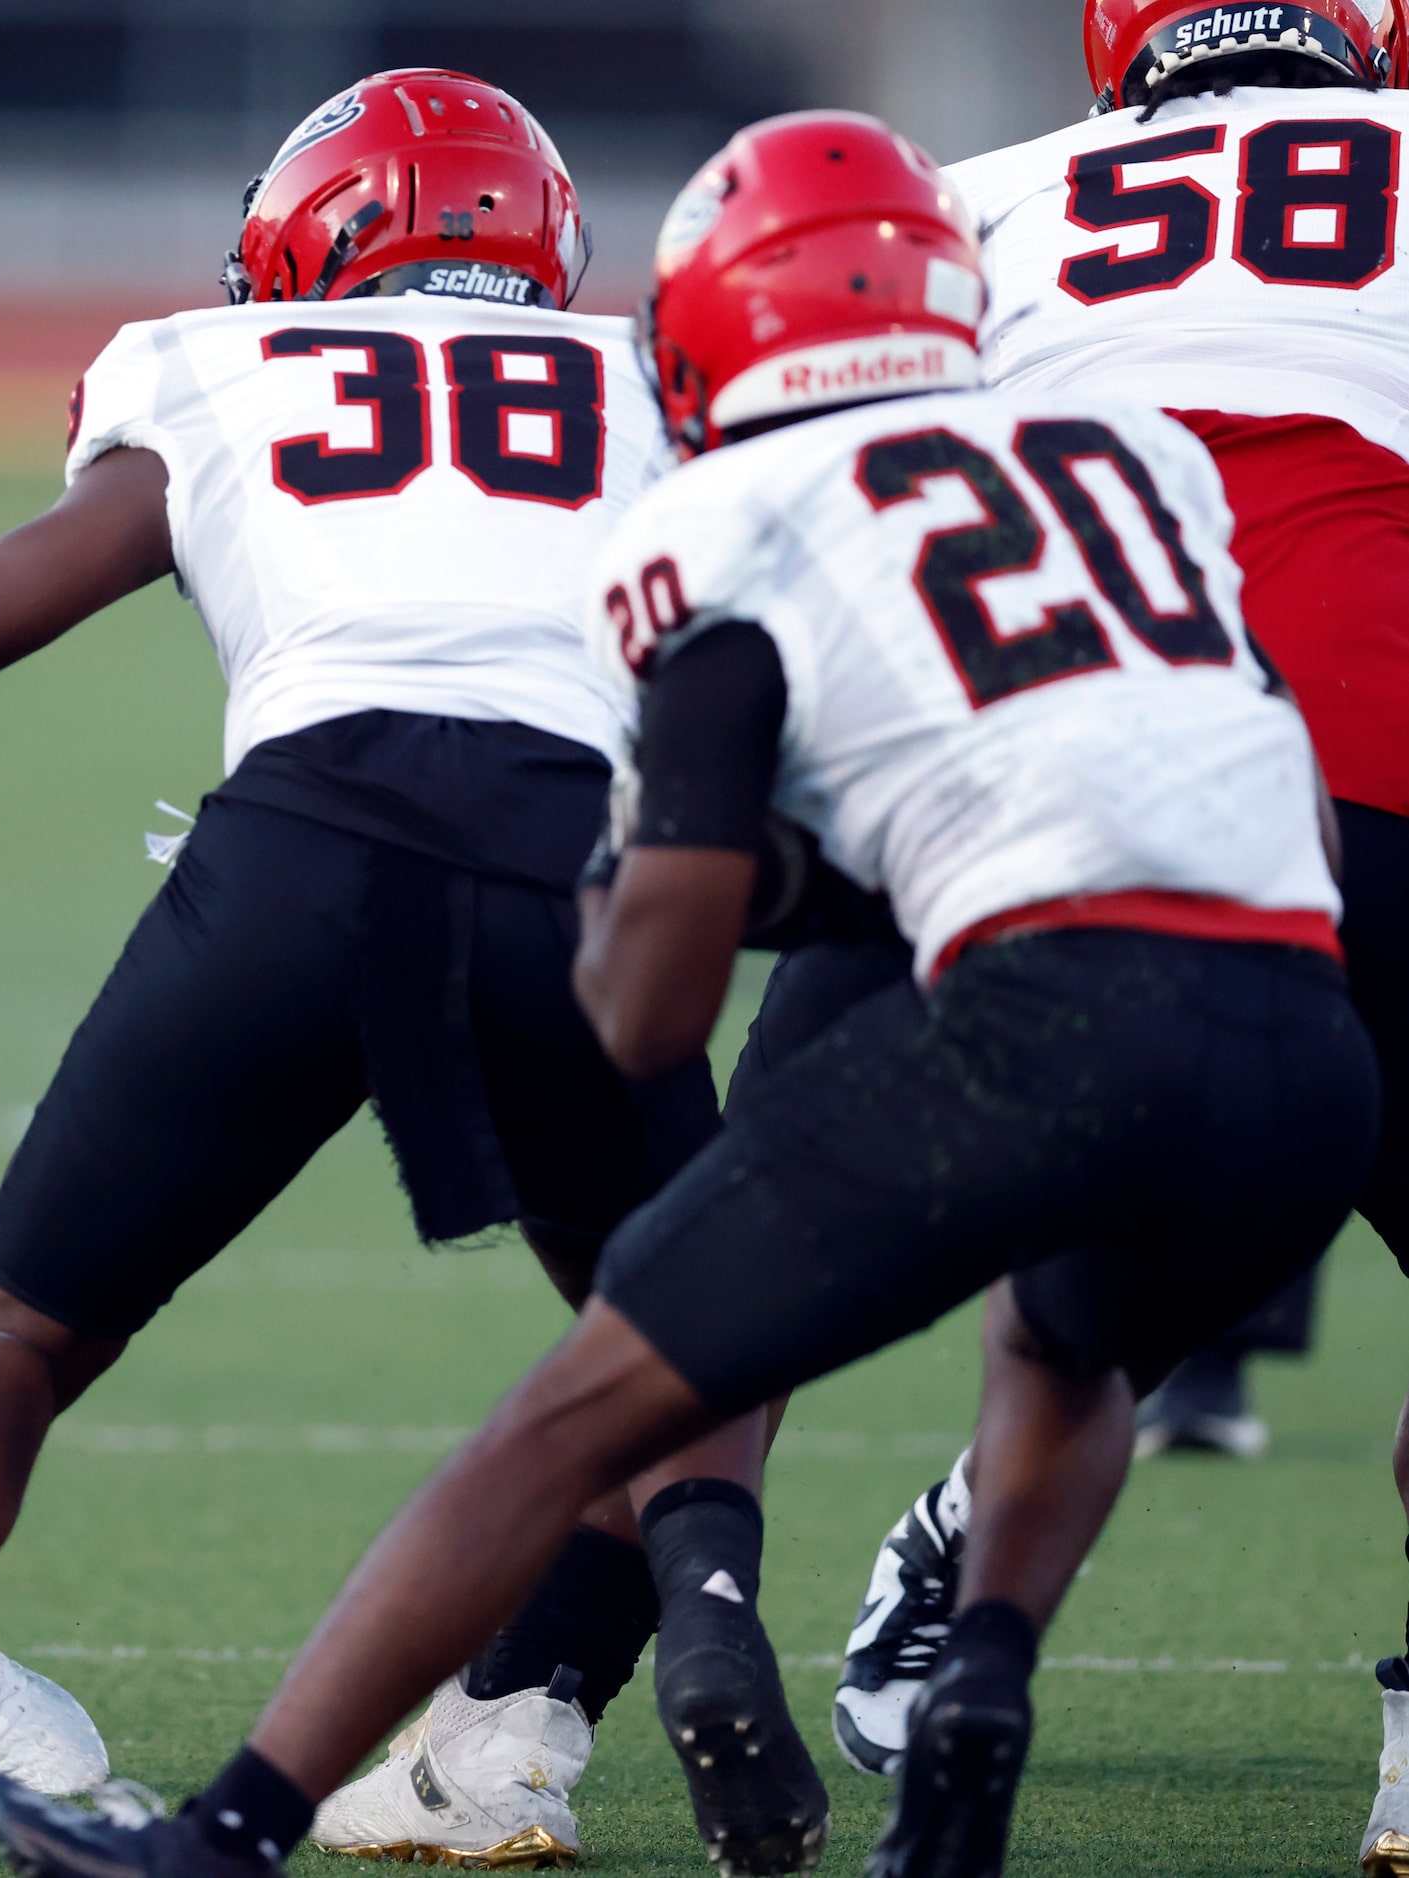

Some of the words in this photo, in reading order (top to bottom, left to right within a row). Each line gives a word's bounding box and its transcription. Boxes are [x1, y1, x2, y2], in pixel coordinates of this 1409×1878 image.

[1175, 6, 1284, 49] schutt
[439, 211, 474, 240] 38
[1057, 118, 1401, 306] 58
[424, 263, 531, 303] schutt
[781, 347, 946, 396] Riddell
[260, 327, 606, 511] 38
[854, 419, 1234, 711] 20
[606, 557, 696, 681] 20
